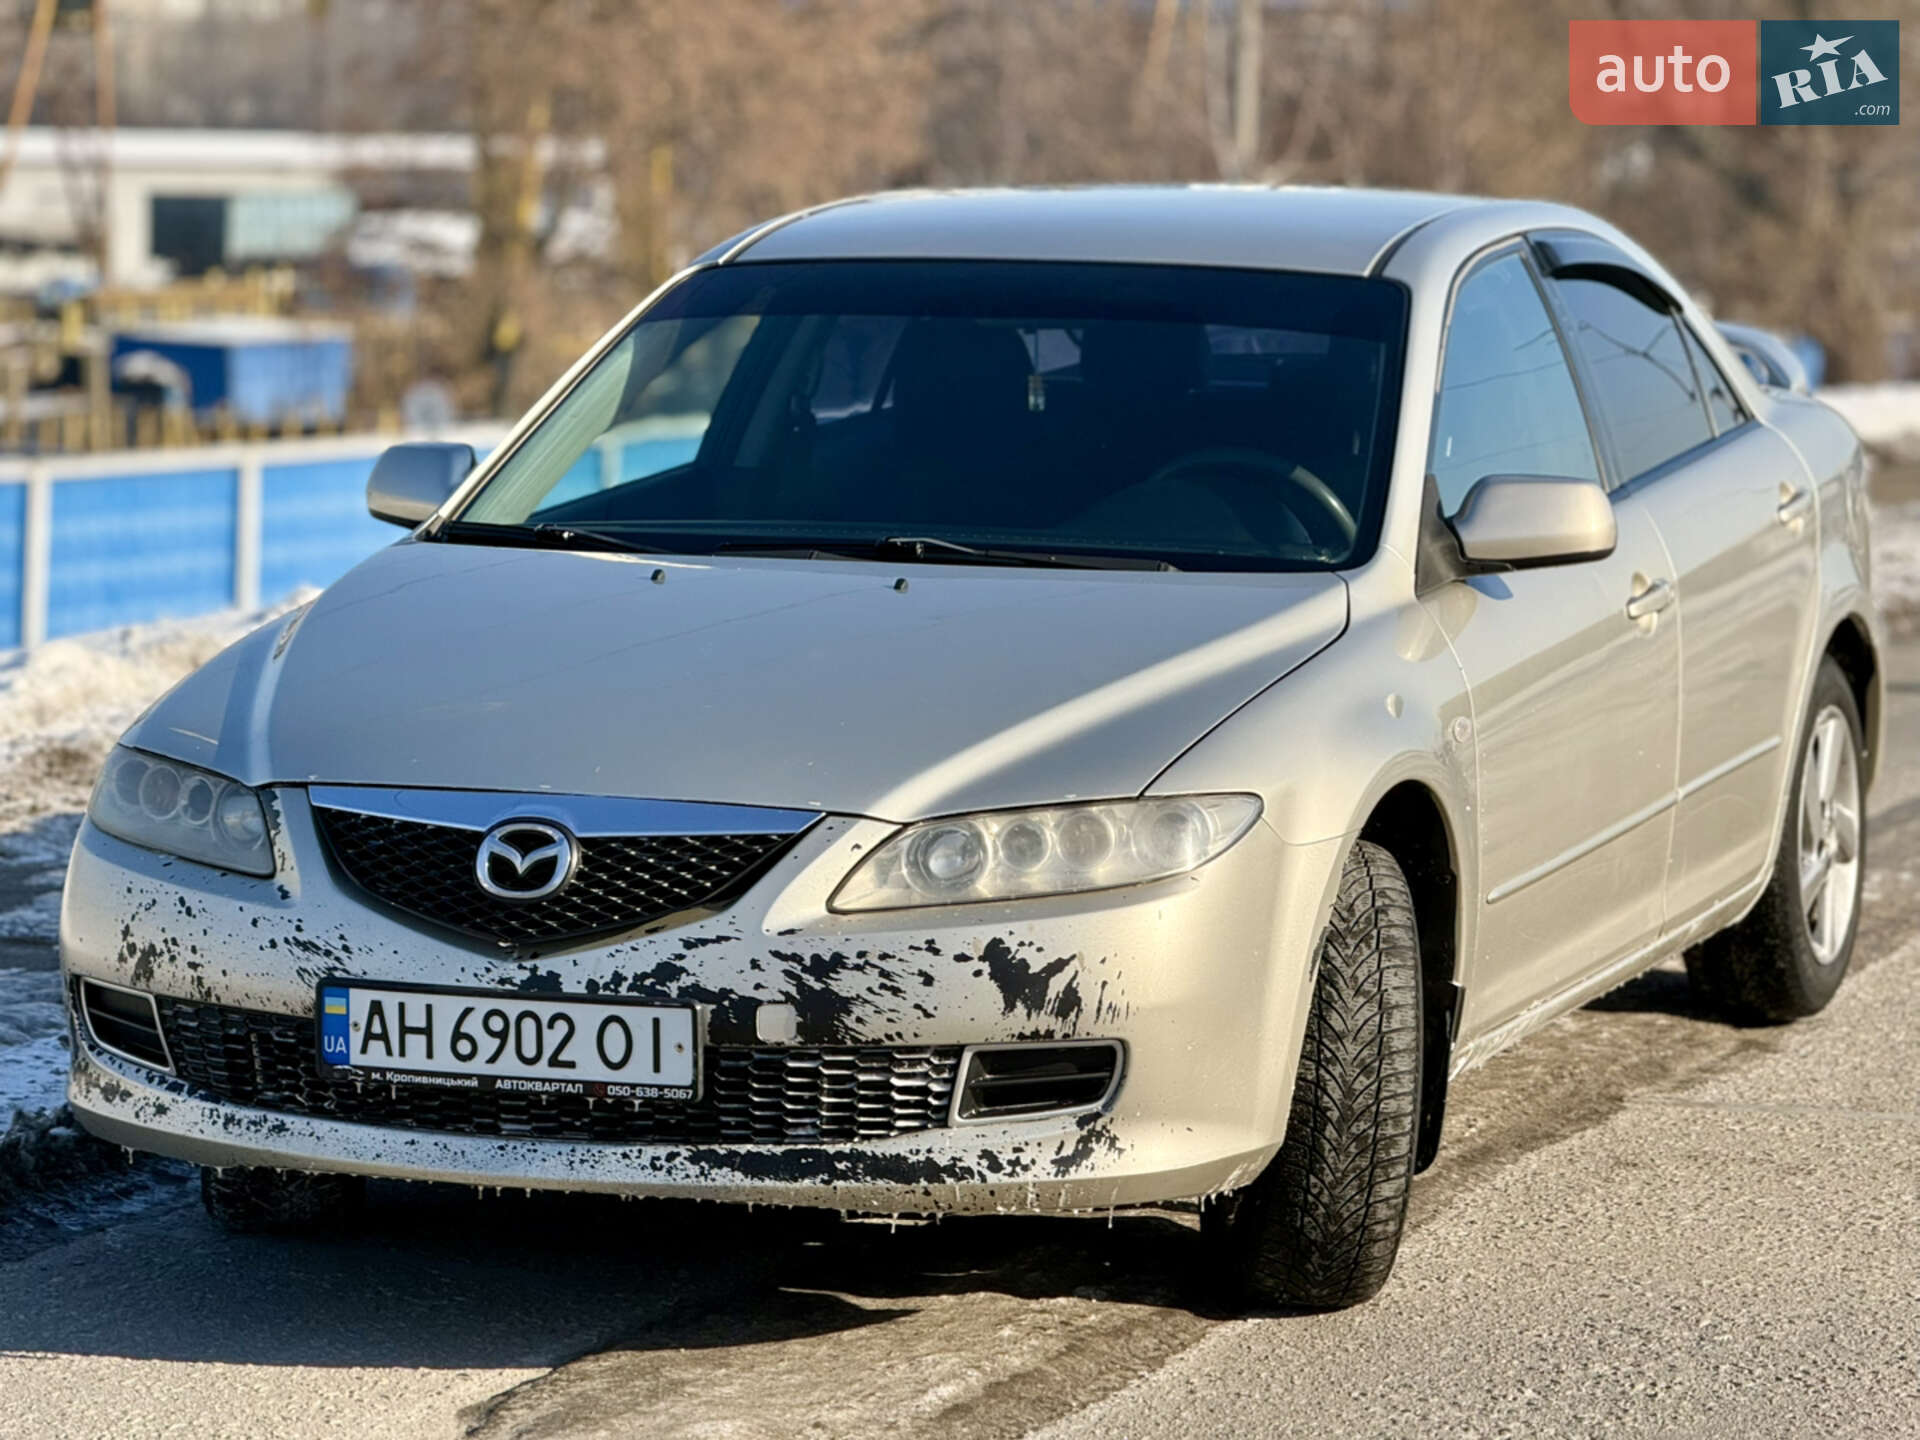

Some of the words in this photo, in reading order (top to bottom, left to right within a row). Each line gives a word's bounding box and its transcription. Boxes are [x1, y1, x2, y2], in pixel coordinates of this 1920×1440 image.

[324, 1035, 347, 1054] UA
[360, 999, 434, 1060] AH
[450, 1006, 577, 1069] 6902
[596, 1014, 661, 1074] OI
[385, 1071, 479, 1088] Кропивницький
[494, 1079, 584, 1094] АВТОКВАРТАЛ
[606, 1084, 693, 1099] 050-638-5067
